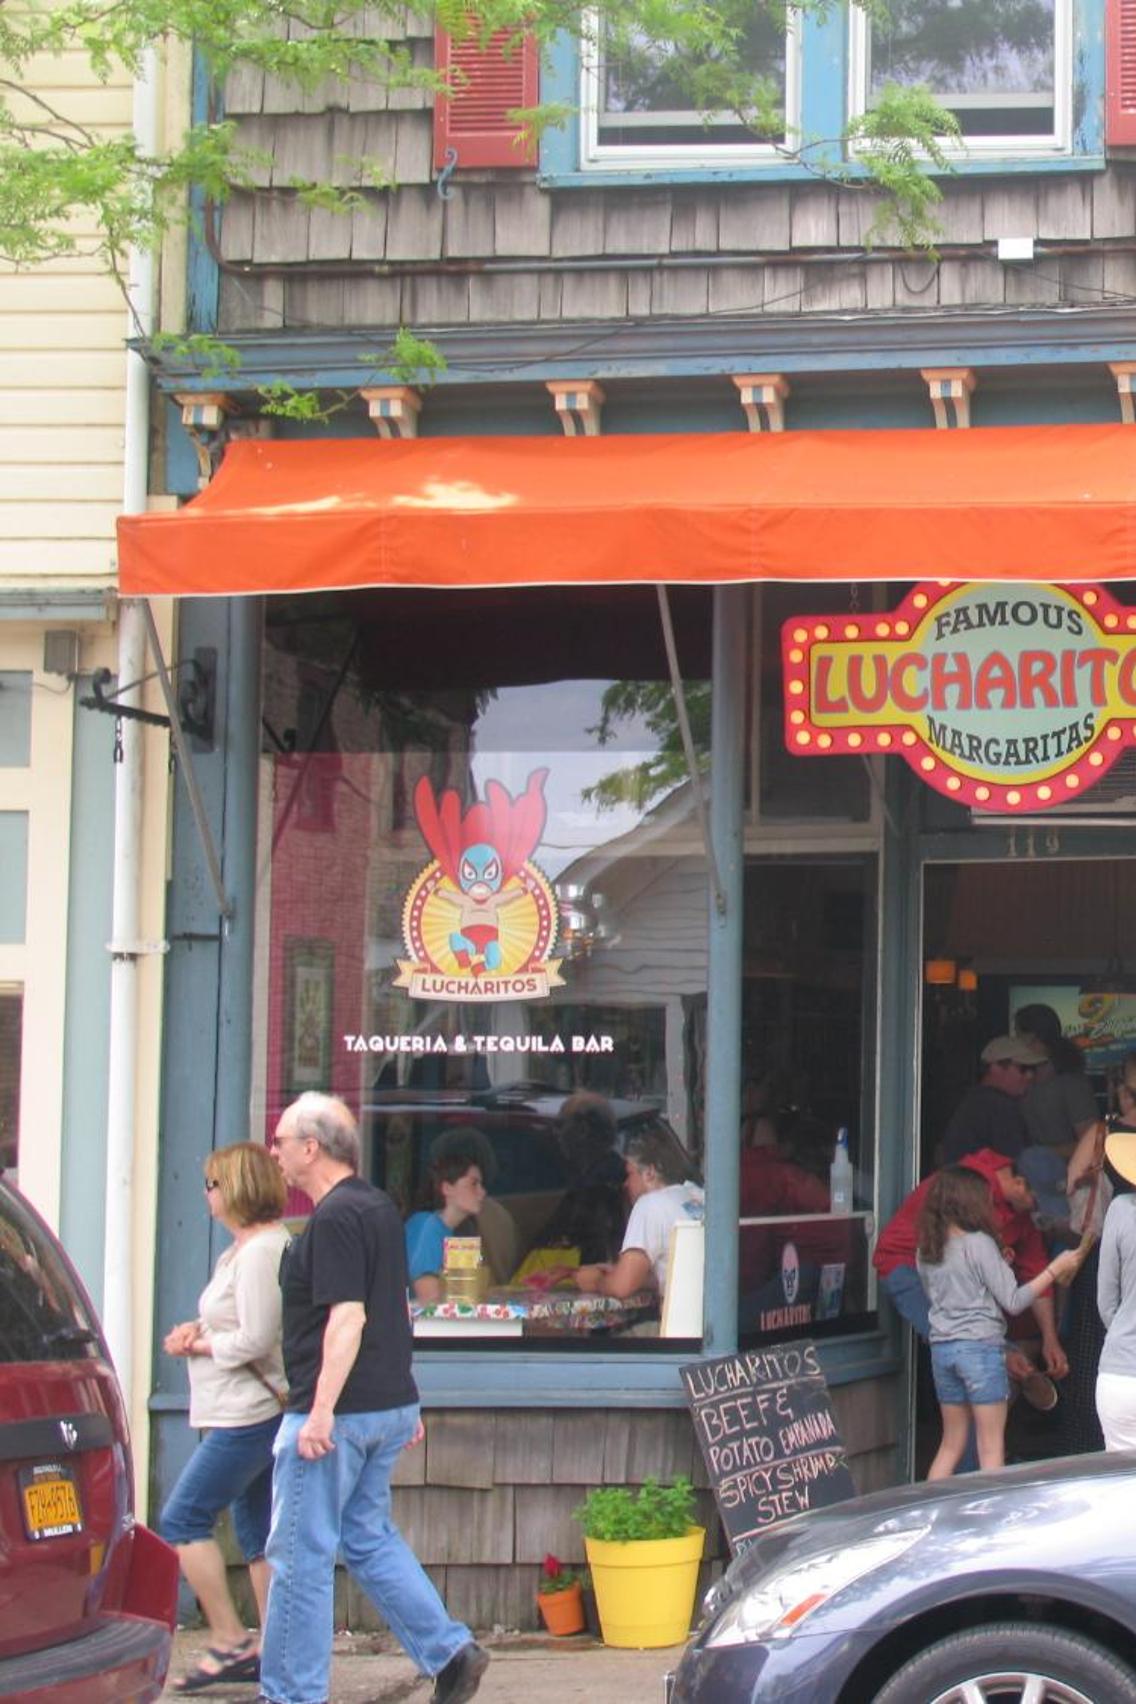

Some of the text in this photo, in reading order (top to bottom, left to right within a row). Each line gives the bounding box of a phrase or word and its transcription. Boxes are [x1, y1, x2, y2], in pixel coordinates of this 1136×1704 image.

[935, 600, 1084, 641] FAMOUS
[926, 712, 1096, 766] MARGARITAS
[420, 977, 538, 995] LUCHARITOS
[343, 1035, 615, 1052] TAQUERIA & TEQUILA BAR
[686, 1346, 822, 1399] LUCHARITOS
[701, 1392, 773, 1444] BEEF
[709, 1436, 775, 1476] POTATO
[718, 1467, 773, 1508] SPICY
[757, 1485, 811, 1524] STEW
